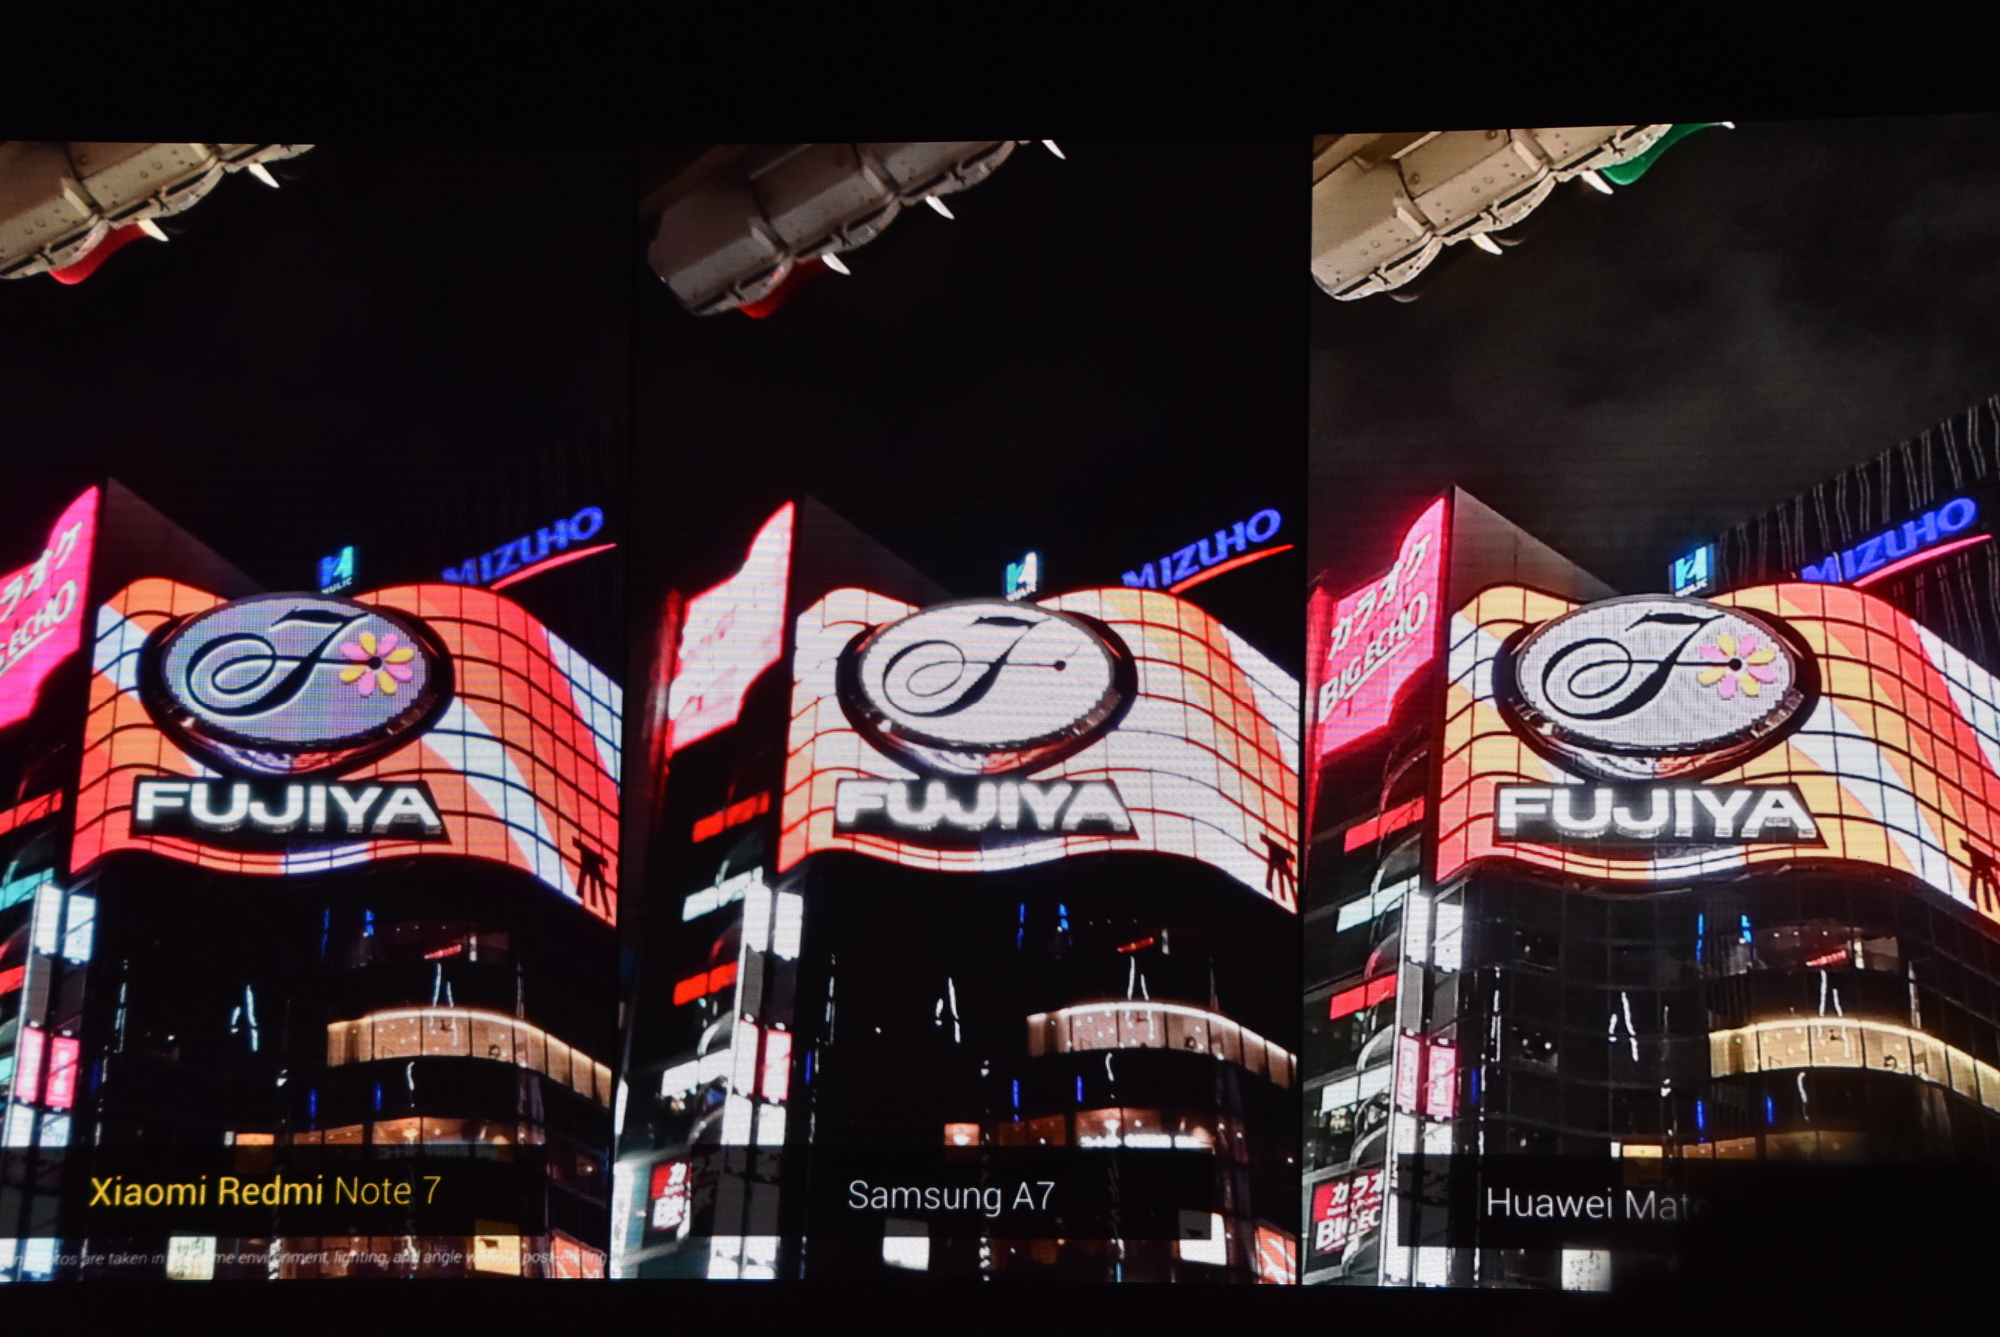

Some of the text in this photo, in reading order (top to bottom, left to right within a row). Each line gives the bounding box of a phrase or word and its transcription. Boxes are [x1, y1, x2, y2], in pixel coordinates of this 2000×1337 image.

[441, 506, 604, 585] MIZUHO
[1121, 508, 1282, 589] MIZUHO
[1801, 497, 1976, 583] MIZUHO
[8, 580, 78, 655] ECHO
[1328, 533, 1432, 660] カラオケ
[1319, 591, 1429, 723] BIG ECHO
[136, 781, 442, 833] FUJIYA
[837, 780, 1131, 831] FUJIYA
[1498, 787, 1818, 838] FUJIYA
[89, 1175, 442, 1206] Xiaomi Redmi Note 7
[849, 1179, 1056, 1218] Samsung A7
[1487, 1187, 1708, 1220] Huawei Mat
[108, 1251, 148, 1265] taken
[151, 1252, 165, 1265] in
[239, 1251, 329, 1266] envionment,
[423, 1250, 461, 1266] angle
